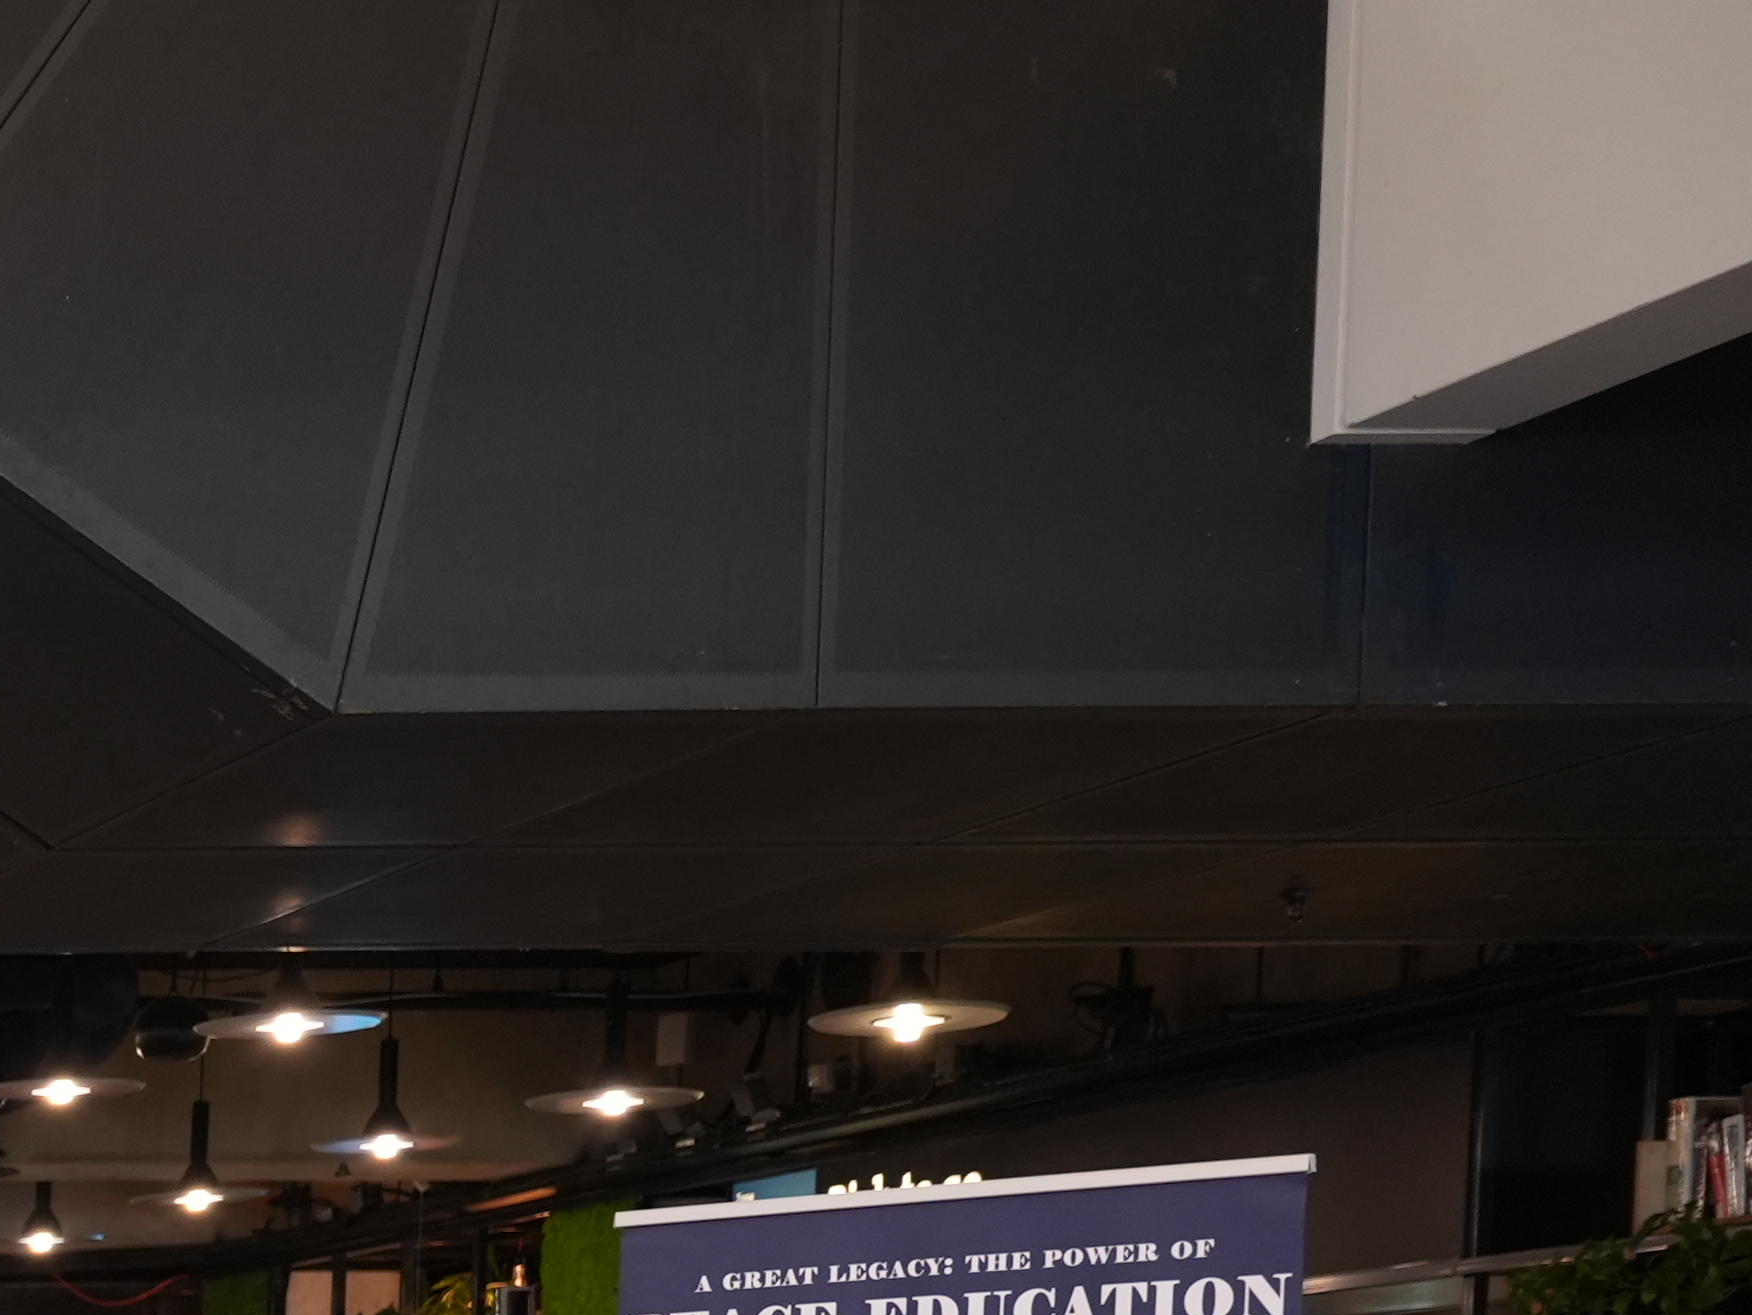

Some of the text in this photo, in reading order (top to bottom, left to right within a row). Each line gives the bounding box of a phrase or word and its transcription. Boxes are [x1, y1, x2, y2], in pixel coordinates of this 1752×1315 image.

[695, 1239, 1214, 1292] A GREAT LEGACY: THE POWER OF
